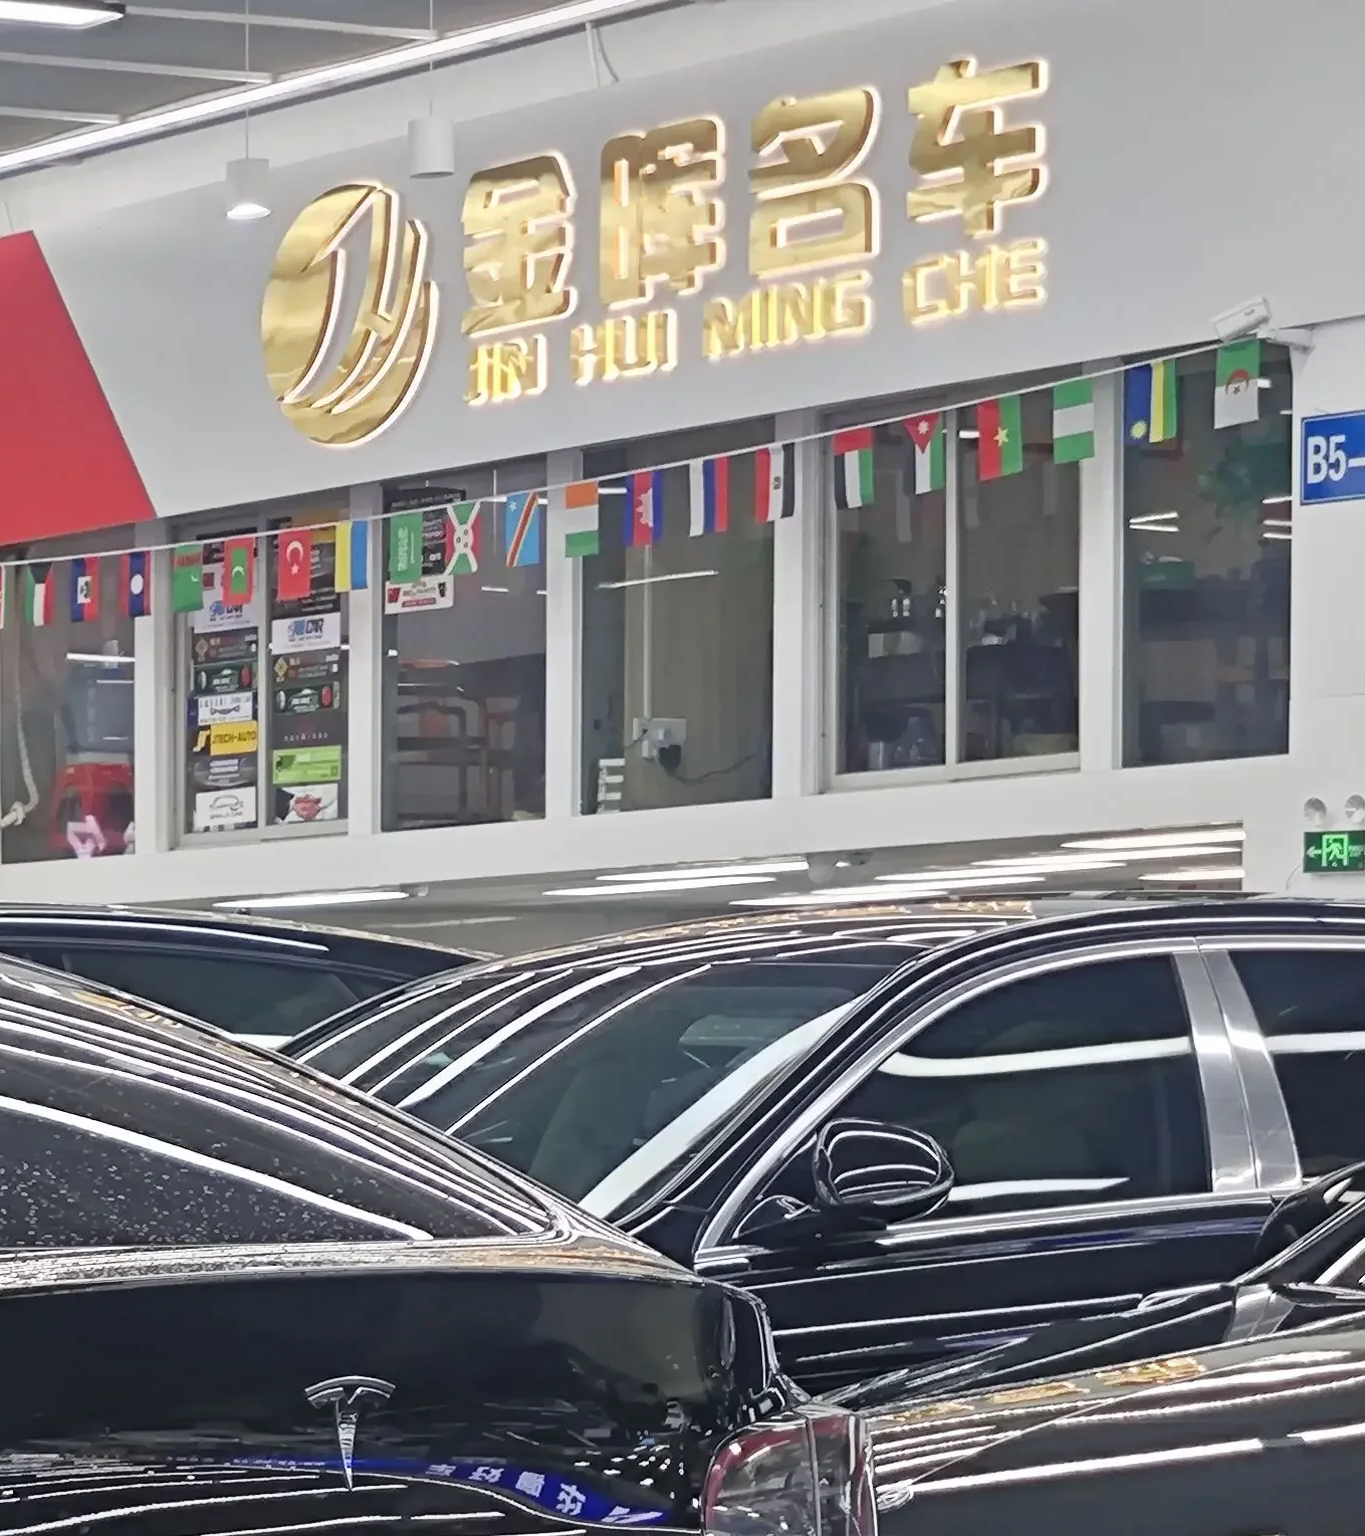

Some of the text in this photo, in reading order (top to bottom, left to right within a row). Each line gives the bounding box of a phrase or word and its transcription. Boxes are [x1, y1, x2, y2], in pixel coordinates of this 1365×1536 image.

[461, 57, 1051, 337] 金晖名车
[703, 270, 875, 362] MING
[902, 238, 1049, 325] CHE
